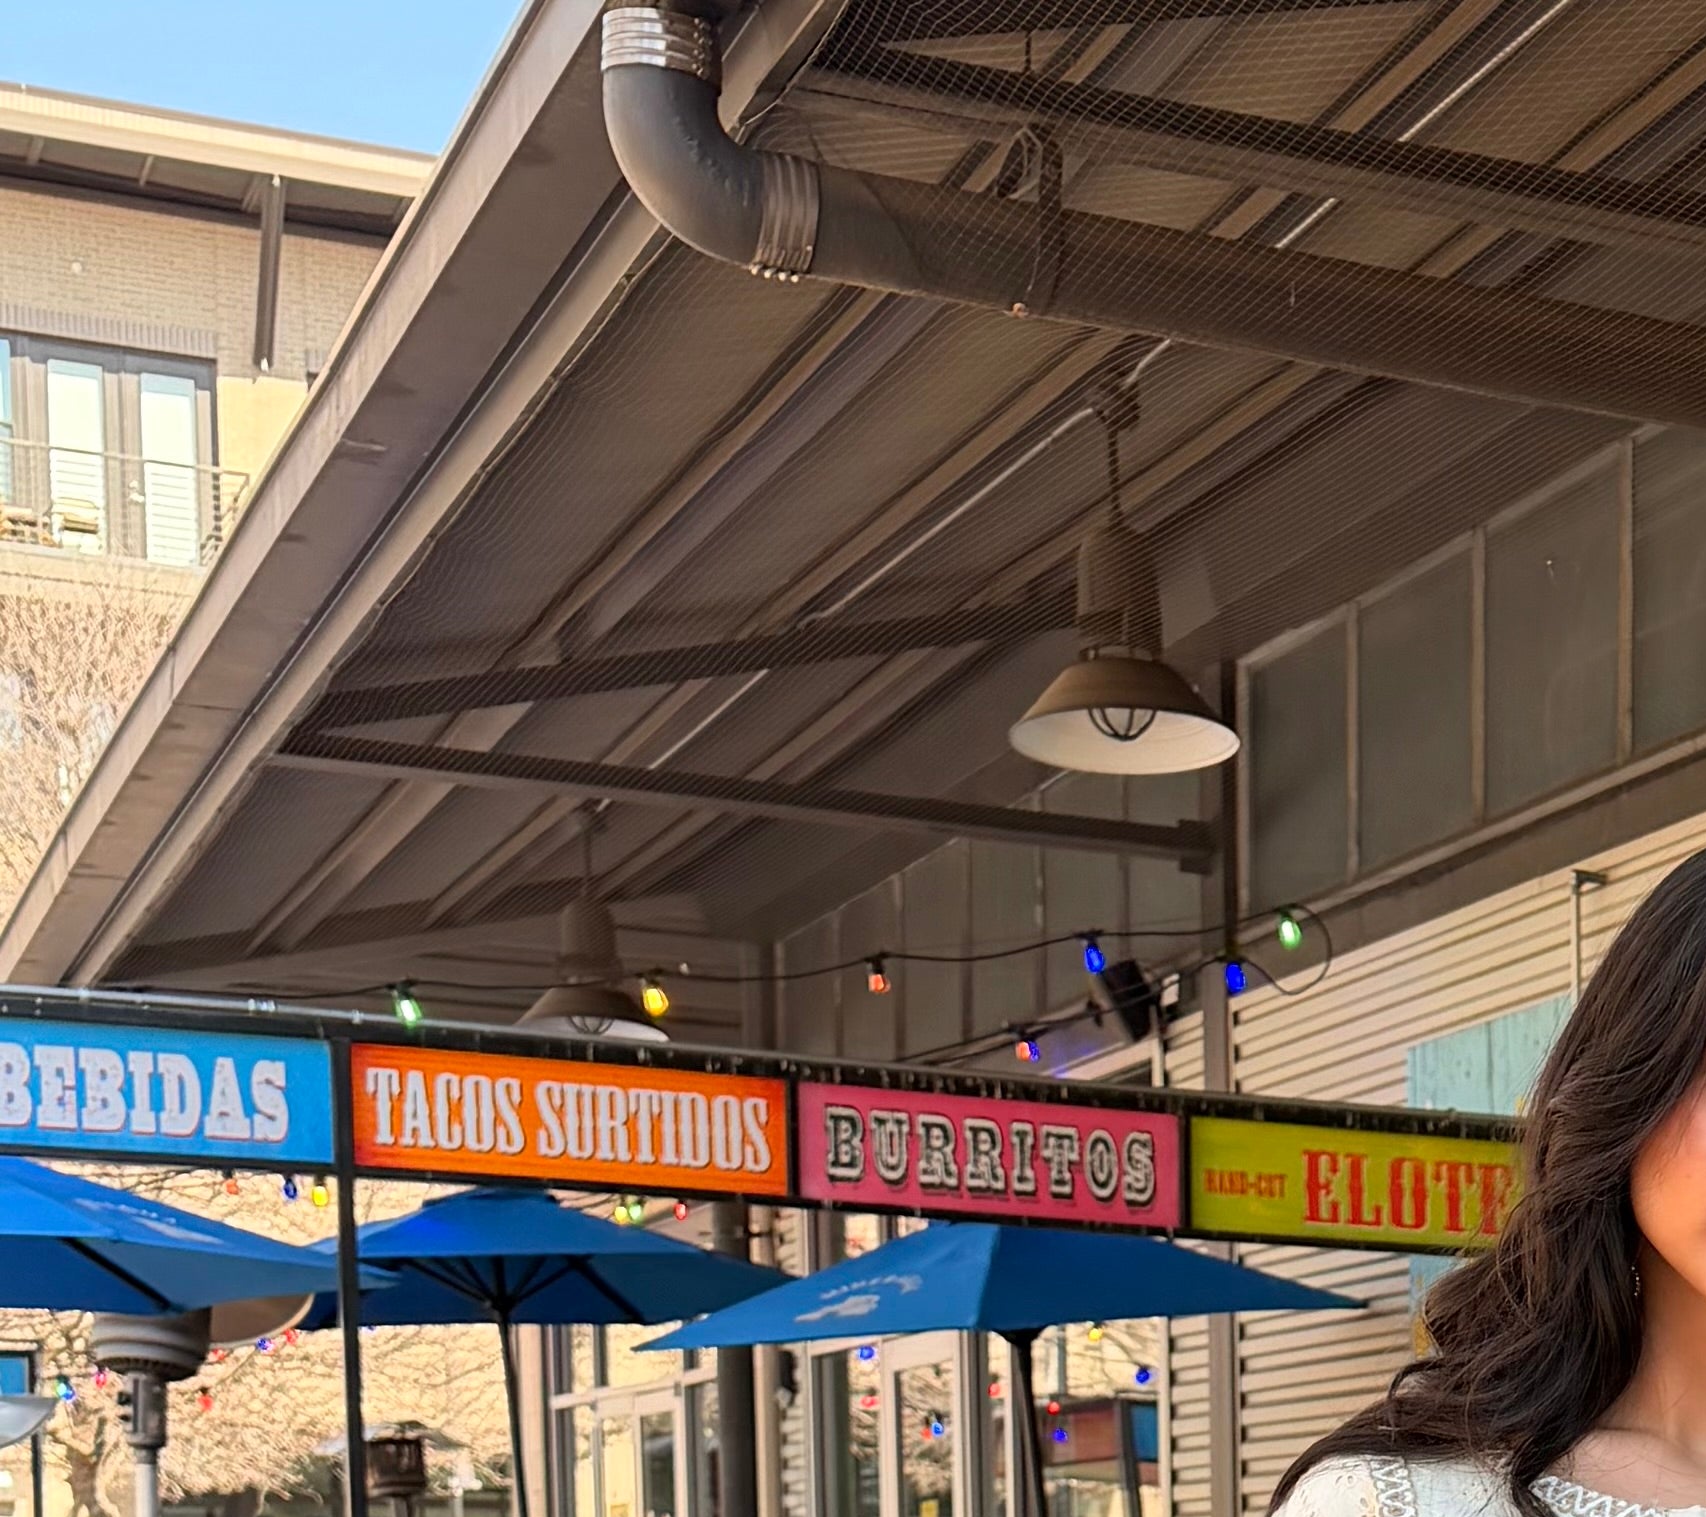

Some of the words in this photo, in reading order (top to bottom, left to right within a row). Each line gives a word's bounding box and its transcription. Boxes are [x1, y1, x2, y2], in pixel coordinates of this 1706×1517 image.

[0, 1041, 290, 1144] BEBIDAS
[365, 1066, 525, 1155] TACOS
[536, 1081, 772, 1174] SURTIDOS
[824, 1105, 1157, 1205] BURRITOS
